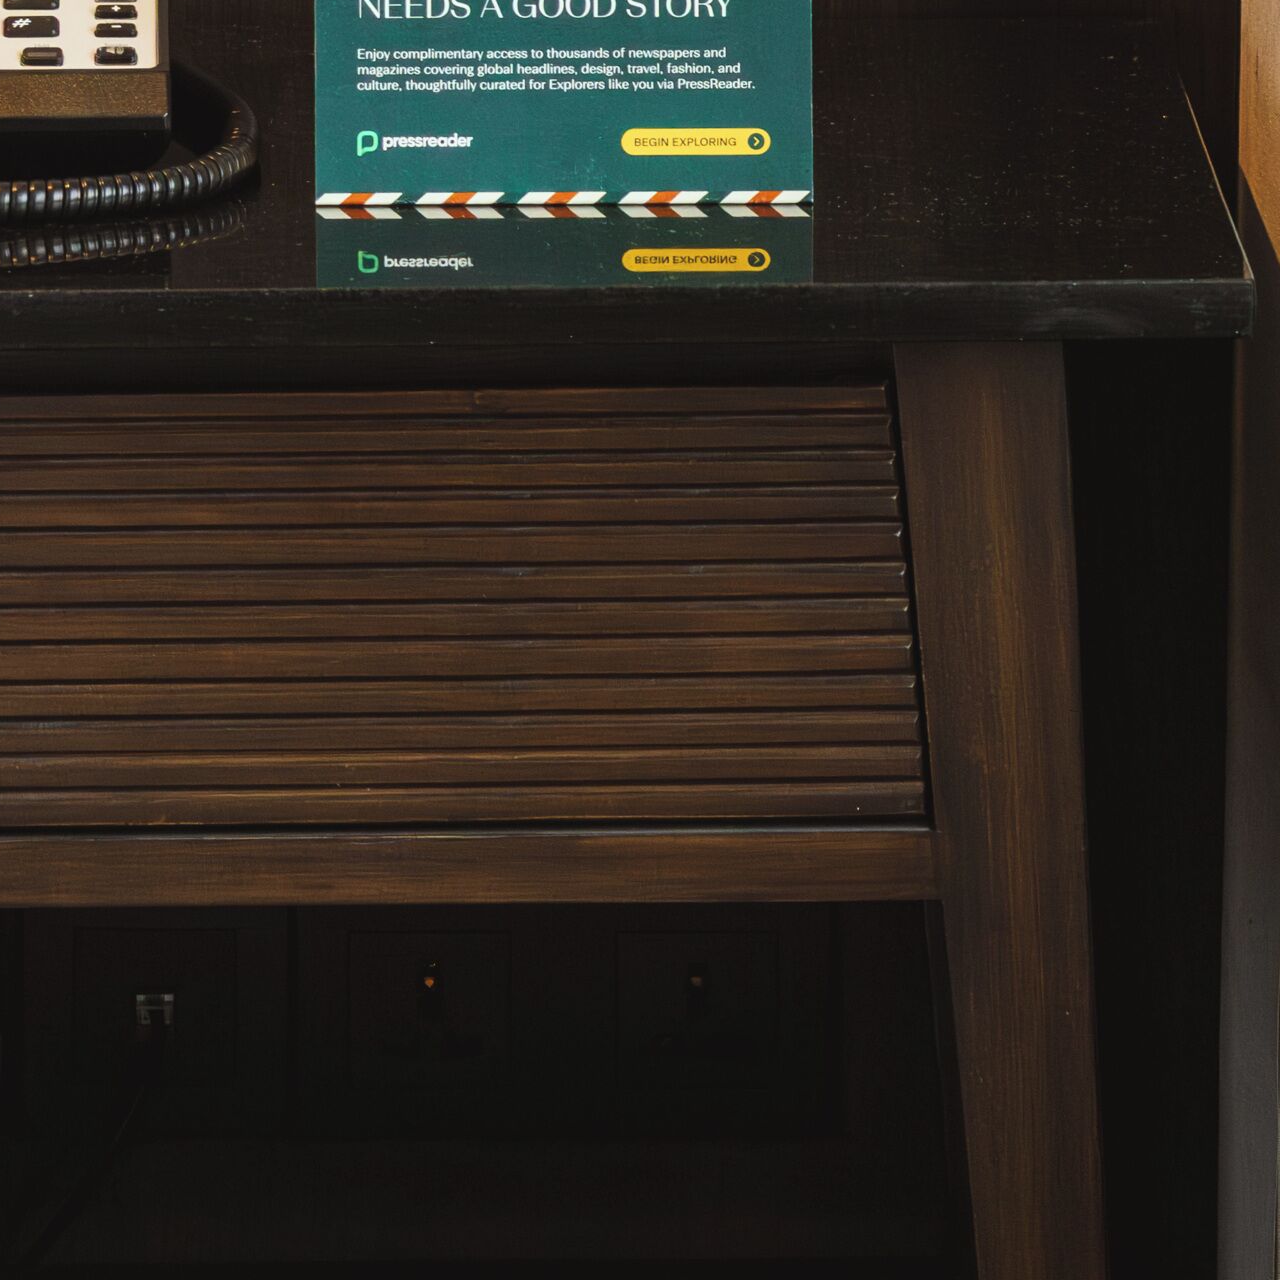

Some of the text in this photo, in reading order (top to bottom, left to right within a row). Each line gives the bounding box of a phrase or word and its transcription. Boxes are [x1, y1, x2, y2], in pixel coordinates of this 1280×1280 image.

[357, 47, 726, 61] Enjoy complimentary access to thousands of newspapers and
[357, 63, 740, 77] magazines covering global headlines, design, travel, fashion, and
[357, 78, 755, 92] culture, thoughtfully curated for Explorers like you via PressReader.
[383, 133, 473, 151] pressreader
[634, 136, 737, 148] BEGIN EXPLORING
